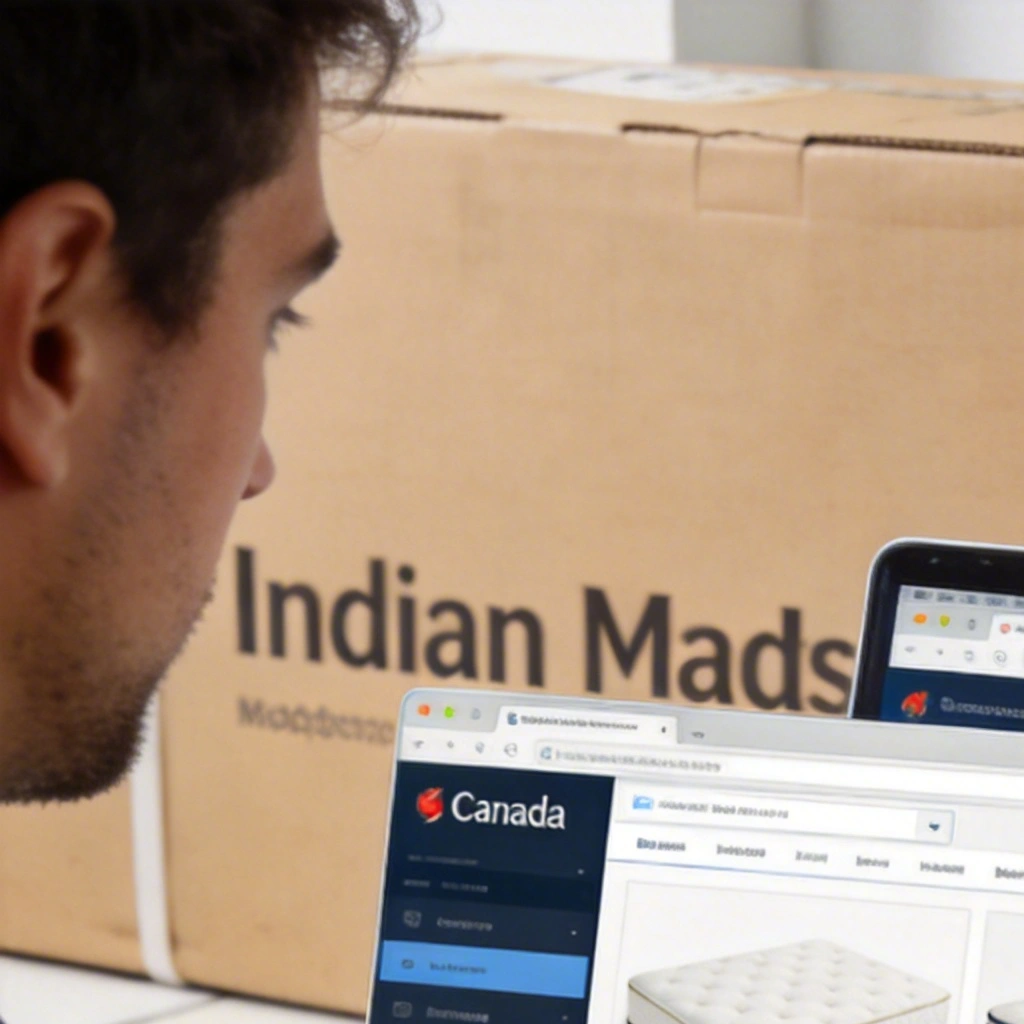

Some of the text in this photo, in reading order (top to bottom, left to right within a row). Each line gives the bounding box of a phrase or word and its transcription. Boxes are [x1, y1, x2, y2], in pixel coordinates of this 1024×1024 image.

[236, 546, 857, 716] Indian Mads
[451, 791, 566, 829] Canada
